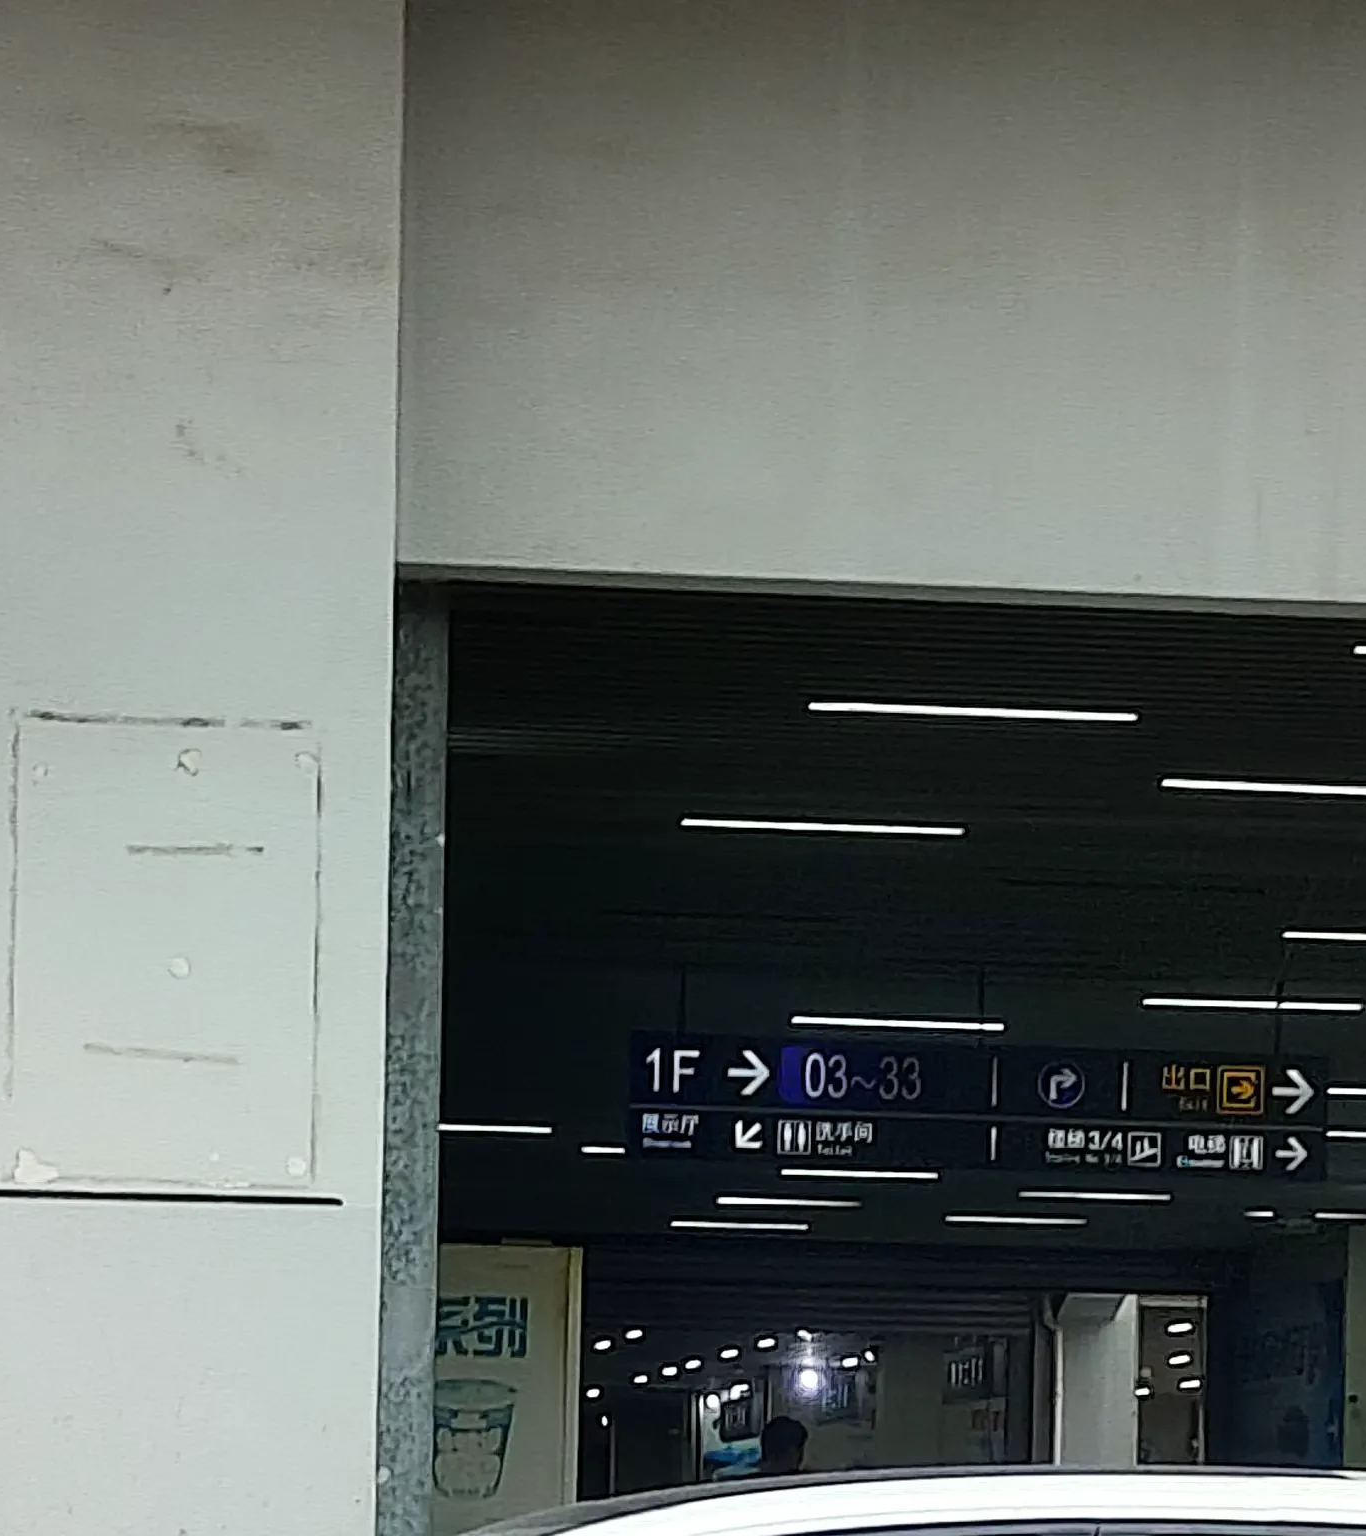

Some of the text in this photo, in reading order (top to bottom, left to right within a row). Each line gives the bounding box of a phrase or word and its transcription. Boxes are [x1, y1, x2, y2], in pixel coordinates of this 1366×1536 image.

[645, 1047, 701, 1093] 1F
[804, 1051, 922, 1101] 03~33
[1161, 1063, 1212, 1091] 出口
